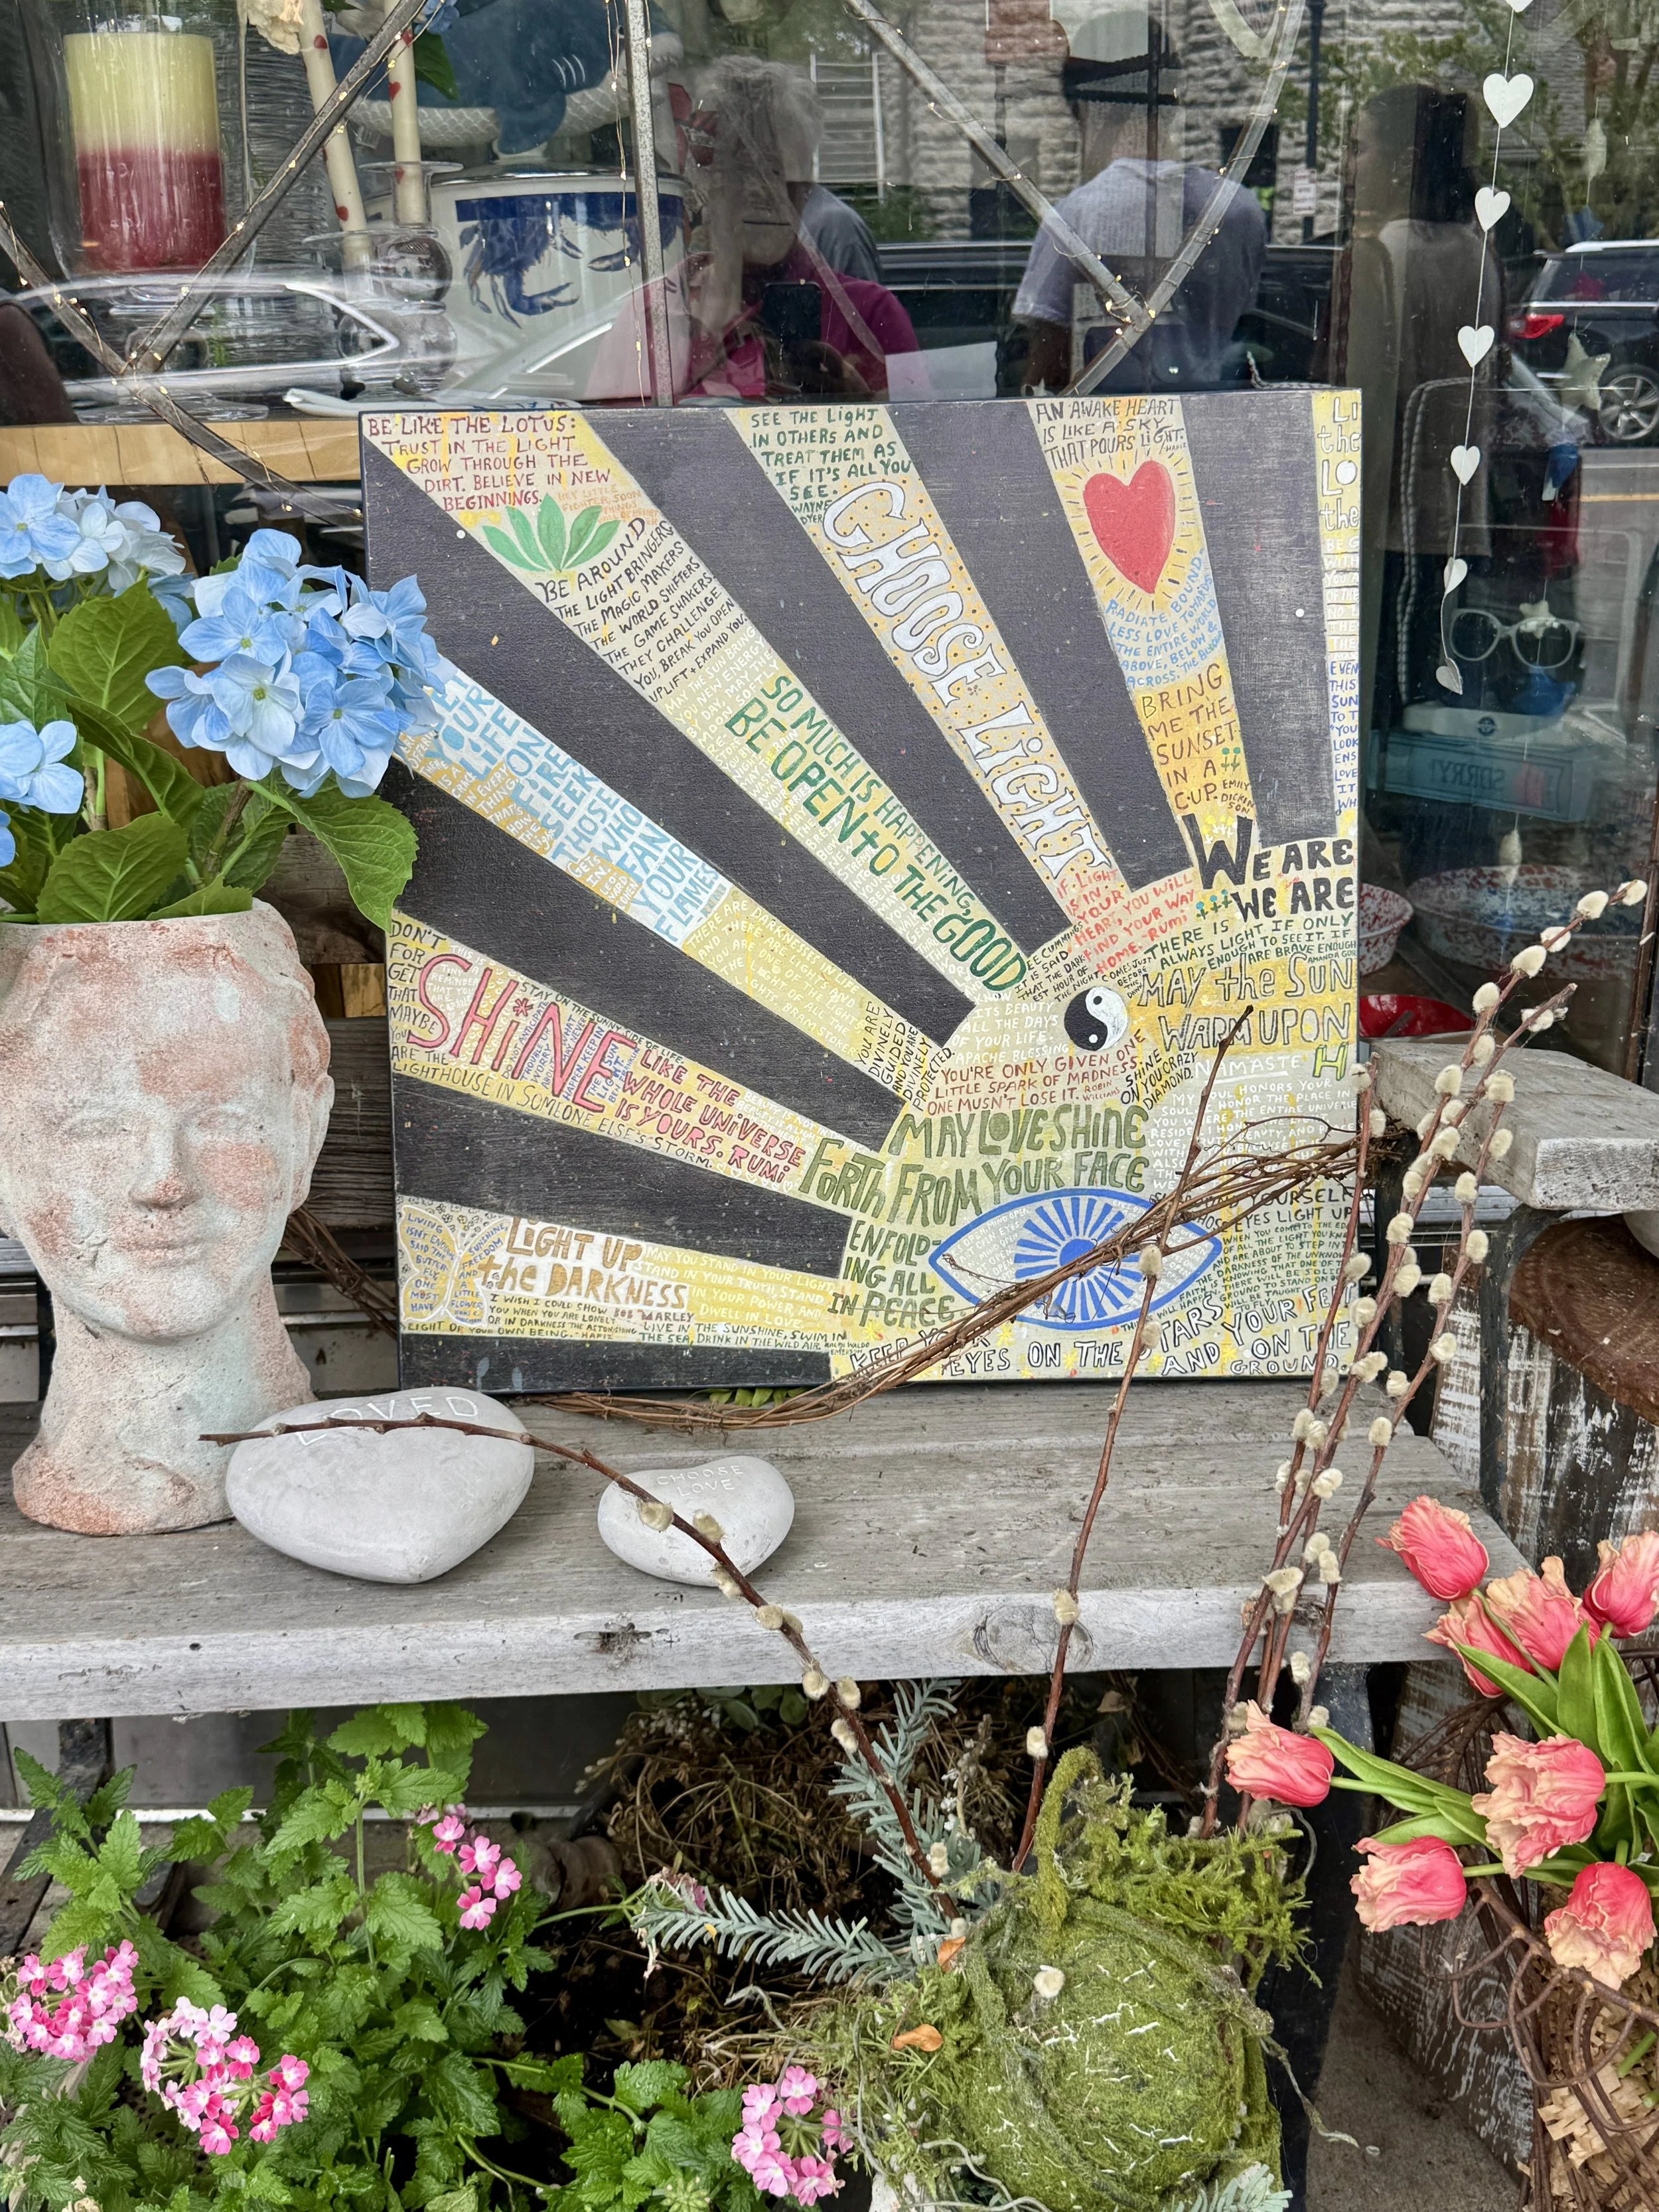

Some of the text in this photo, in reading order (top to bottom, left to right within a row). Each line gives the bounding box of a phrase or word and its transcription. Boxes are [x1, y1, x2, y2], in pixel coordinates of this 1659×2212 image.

[368, 415, 577, 437] BE LIKE THE LOTUS:
[751, 412, 782, 427] SEE
[790, 411, 818, 423] THE
[1036, 399, 1179, 423] AN AWAKE HEART
[1043, 417, 1165, 445] IS LIKE A SKY
[382, 435, 575, 456] TRUST IN THE LIGHT
[753, 424, 883, 447] IN OTHERS AND
[760, 441, 897, 467] TREAT THEM AS
[1045, 440, 1086, 471] THAT
[1090, 435, 1135, 457] POURS
[1317, 424, 1362, 454] the
[407, 453, 588, 474] GROW THROUGH THE
[425, 469, 611, 493] DIRT. BELIEVE IN NEW
[775, 459, 912, 486] IF IT'S ALL YOU
[443, 490, 542, 512] BEGINNINGS.
[790, 484, 838, 500] SEE.
[535, 517, 645, 603] BE AROUND
[555, 604, 581, 620] THE
[586, 574, 622, 611] LIGHT
[823, 480, 1007, 708] CHOOSE
[665, 625, 757, 716] MAY THE SUN BRING
[1141, 663, 1223, 719] BRING
[760, 676, 803, 713] SO
[790, 706, 861, 780] MUCH
[849, 771, 883, 803] IS
[1147, 697, 1231, 741] ME THE
[505, 727, 545, 777] ON
[1157, 719, 1237, 765] SUNSET
[1167, 759, 1217, 788] IN A
[541, 766, 600, 839] SEEK
[551, 787, 620, 862] THOSE
[591, 803, 643, 861] WHO
[615, 820, 671, 885] FAN
[724, 697, 788, 755] BE
[770, 740, 869, 844] OPEN
[893, 863, 949, 922] THE
[932, 913, 1027, 992] GOOD
[1182, 812, 1354, 890] WE ARE
[630, 842, 699, 915] YOUR
[1230, 877, 1355, 922] WE ARE
[654, 861, 720, 942] FLAMES
[390, 919, 447, 950] DON'T
[687, 913, 723, 949] THERE
[723, 900, 748, 917] ARE
[821, 963, 837, 975] IN
[834, 974, 859, 994] LIFE
[388, 963, 423, 984] GET
[388, 985, 417, 1002] THAT
[1137, 967, 1207, 1009] MAY
[1285, 951, 1352, 997] SUN
[390, 1003, 438, 1035] MAYBE
[854, 1001, 879, 1065] YOU ARE
[1158, 1003, 1350, 1053] WARM UPON
[392, 1046, 449, 1066] ARE THE
[869, 1008, 894, 1078] DIVINELY
[881, 1022, 906, 1084] GUIDED
[941, 1028, 1147, 1085] YOU'RE ONLY GIVEN ONE
[622, 1070, 698, 1114] WHOLE
[639, 1048, 741, 1108] LIKE THE
[1238, 1078, 1333, 1096] HONORS YOUR
[393, 1063, 494, 1096] LIGHTHOUSE
[498, 1082, 516, 1102] IN
[516, 1084, 595, 1128] SOMEONE
[651, 1136, 712, 1169] STORM.
[614, 1098, 639, 1122] IS
[636, 1106, 723, 1158] YOURS.
[887, 1113, 976, 1159] MAY
[978, 1109, 1048, 1155] LOVE
[887, 1163, 981, 1228] FROM
[981, 1157, 1065, 1205] YOUR
[1074, 1151, 1150, 1193] FACE
[603, 1236, 643, 1272] UP
[849, 1220, 942, 1267] ENFOLD-
[478, 1254, 688, 1311] the DARKNESS
[842, 1256, 936, 1296] ING ALL
[545, 1300, 572, 1309] COULD
[576, 1303, 608, 1315] SHOW
[828, 1292, 859, 1316] IN
[1027, 1341, 1061, 1368] ON
[1074, 1341, 1123, 1368] THE
[656, 1464, 744, 1485] CHOOSE
[677, 1479, 735, 1497] LOVE
